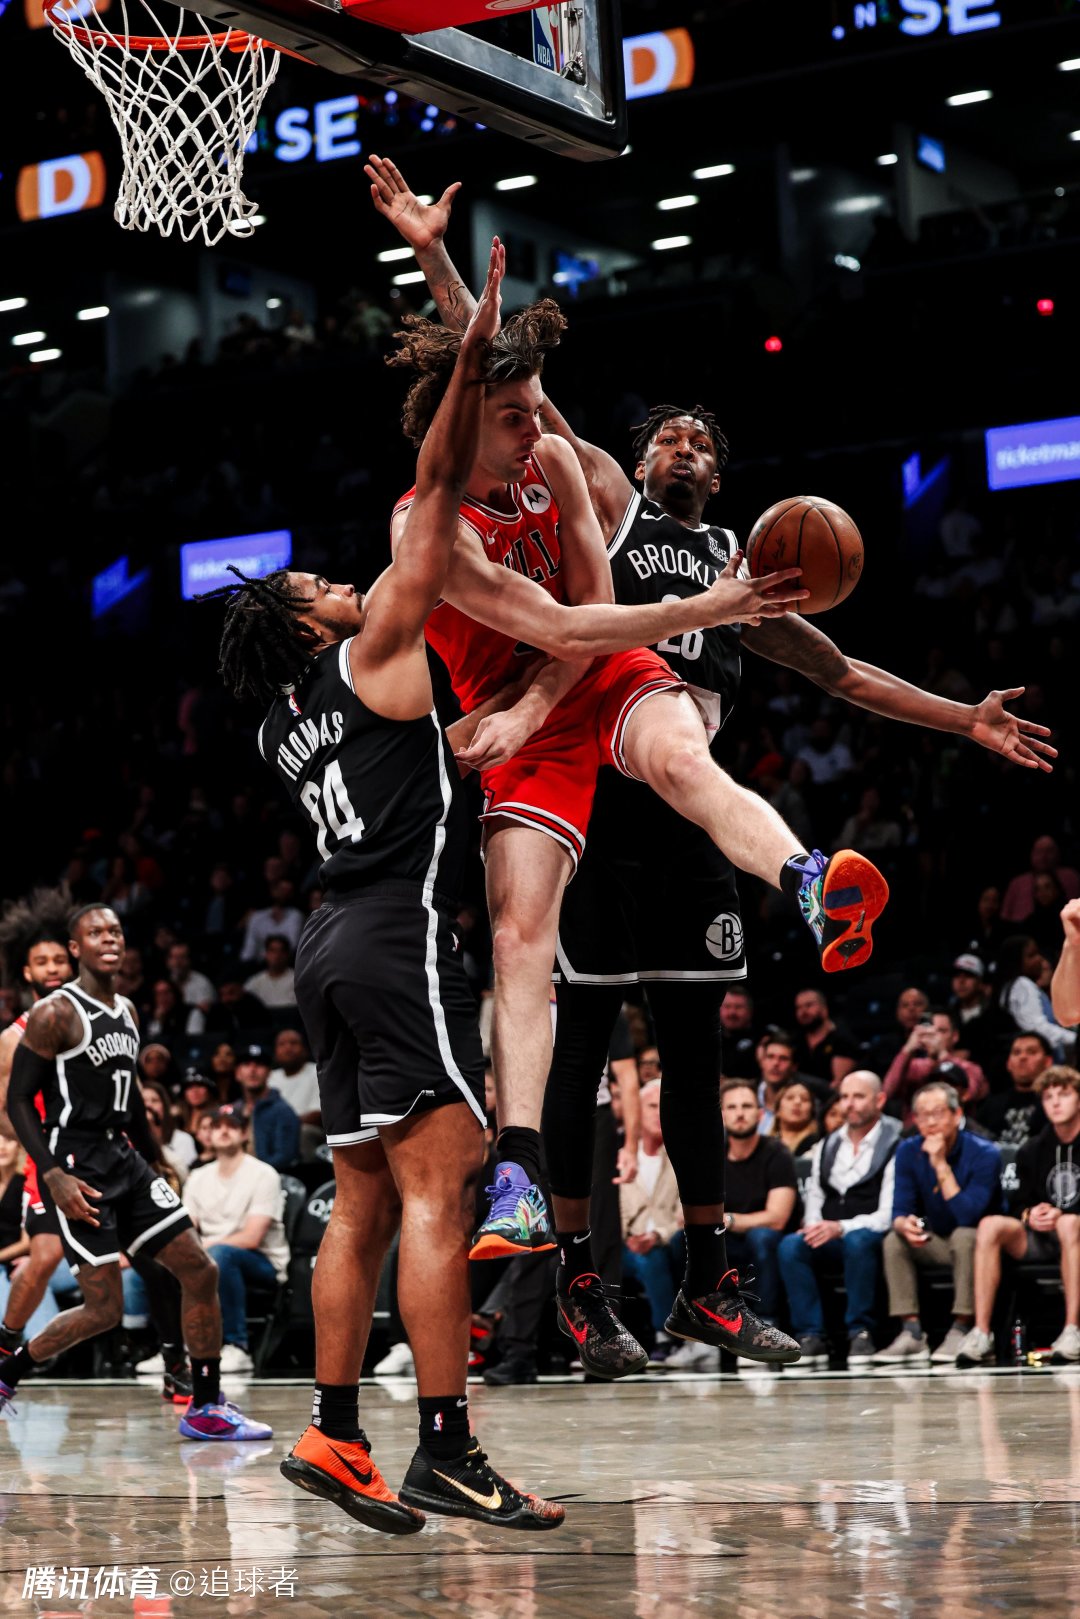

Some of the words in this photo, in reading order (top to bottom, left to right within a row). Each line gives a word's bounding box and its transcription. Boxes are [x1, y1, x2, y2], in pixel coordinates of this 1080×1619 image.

[537, 43, 552, 67] NBA
[627, 544, 719, 589] BROOKL
[278, 711, 344, 781] THOMAS
[112, 1069, 132, 1112] 17
